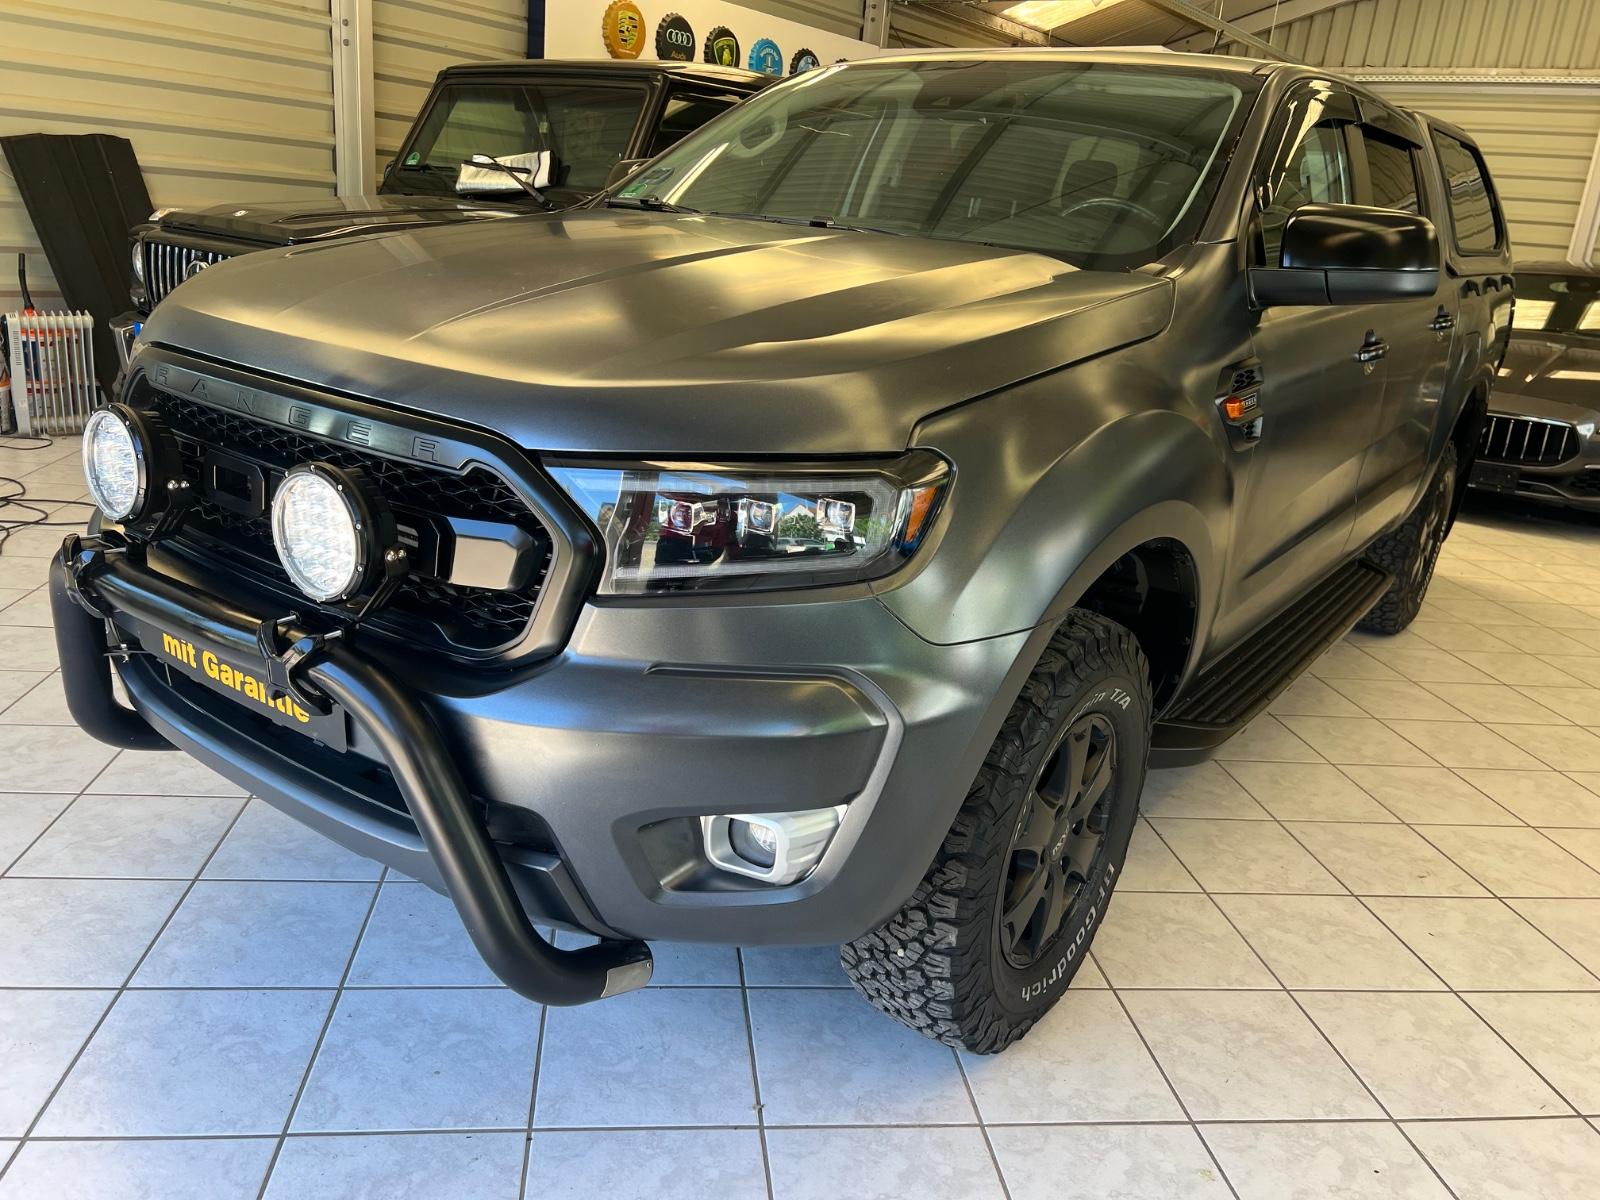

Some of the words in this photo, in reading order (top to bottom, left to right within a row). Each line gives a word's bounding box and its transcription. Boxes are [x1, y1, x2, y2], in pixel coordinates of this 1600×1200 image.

[154, 365, 441, 462] RANGER
[162, 632, 198, 669] mit
[1110, 688, 1131, 710] T/A
